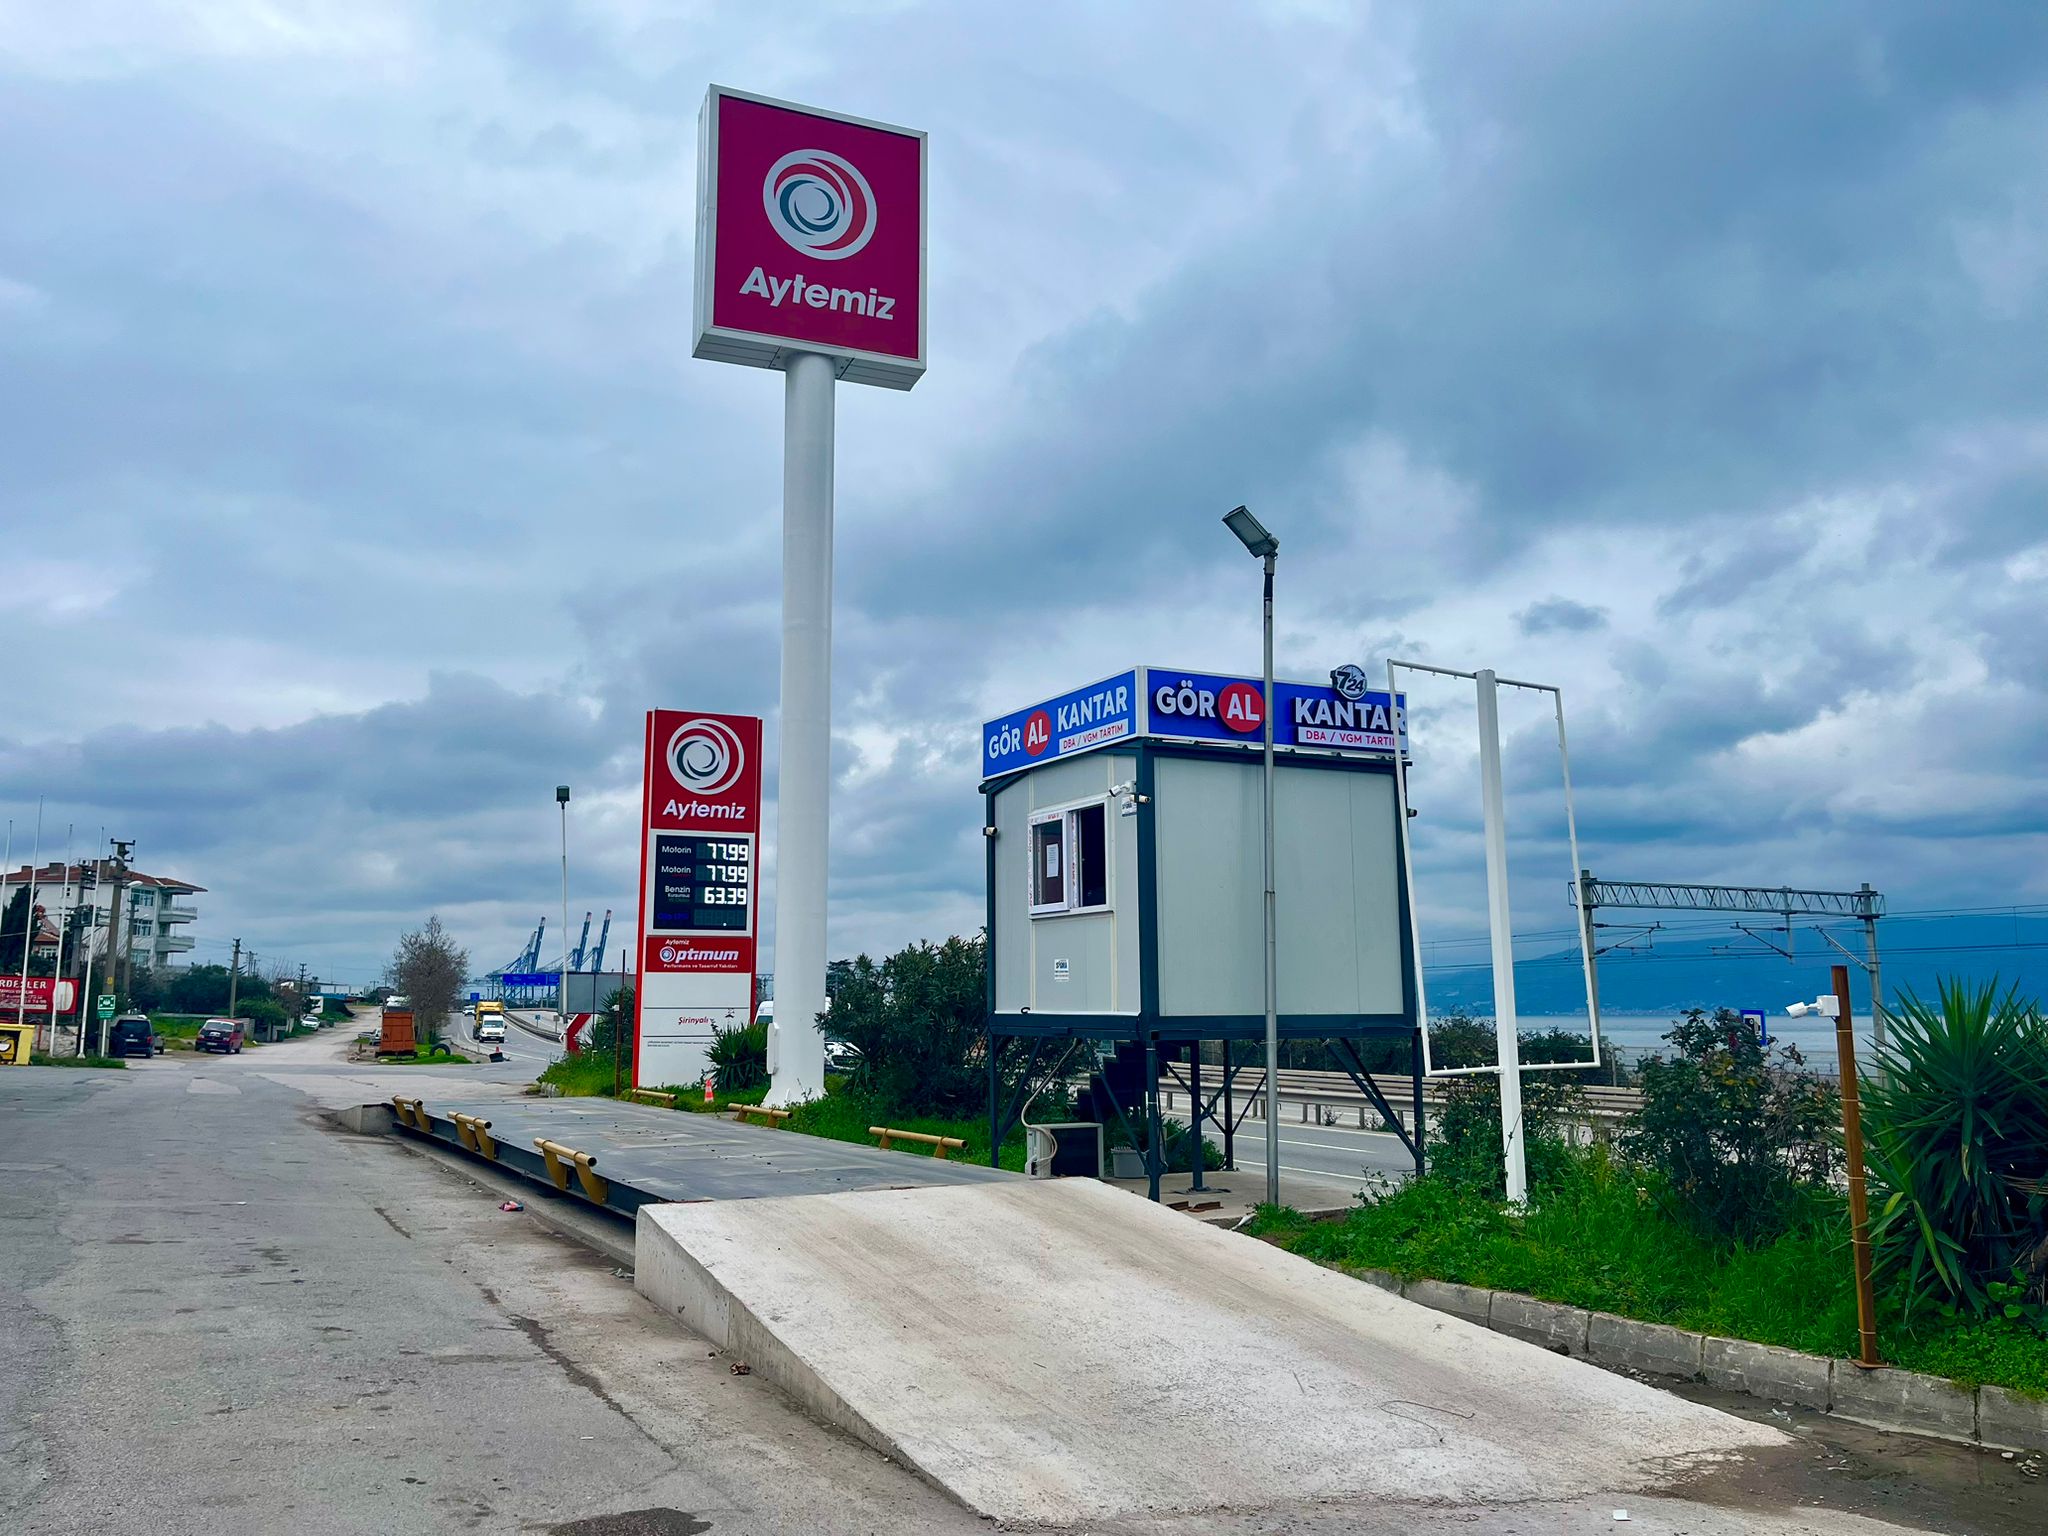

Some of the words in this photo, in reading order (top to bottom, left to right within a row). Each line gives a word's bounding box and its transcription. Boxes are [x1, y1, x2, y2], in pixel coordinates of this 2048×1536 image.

[739, 266, 896, 320] Aytemiz
[1156, 679, 1216, 718] GÖR
[1226, 692, 1260, 721] AL
[988, 723, 1021, 759] GÖR
[1027, 718, 1048, 747] AL
[1057, 685, 1128, 733] KANTAR
[1063, 737, 1076, 749] DBA
[1083, 732, 1098, 744] VGM
[1099, 723, 1123, 740] TARTIM
[1305, 730, 1327, 741] DBA
[1339, 732, 1363, 744] VGM
[1365, 734, 1396, 747] TARTI
[662, 799, 747, 820] Aytemiz
[661, 845, 692, 854] Motorin
[706, 842, 749, 861] 77.99
[660, 865, 691, 874] Motorin
[705, 864, 748, 883] 77.99
[664, 885, 691, 893] Benzin
[703, 886, 747, 905] 63.39
[659, 945, 739, 964] Optimum
